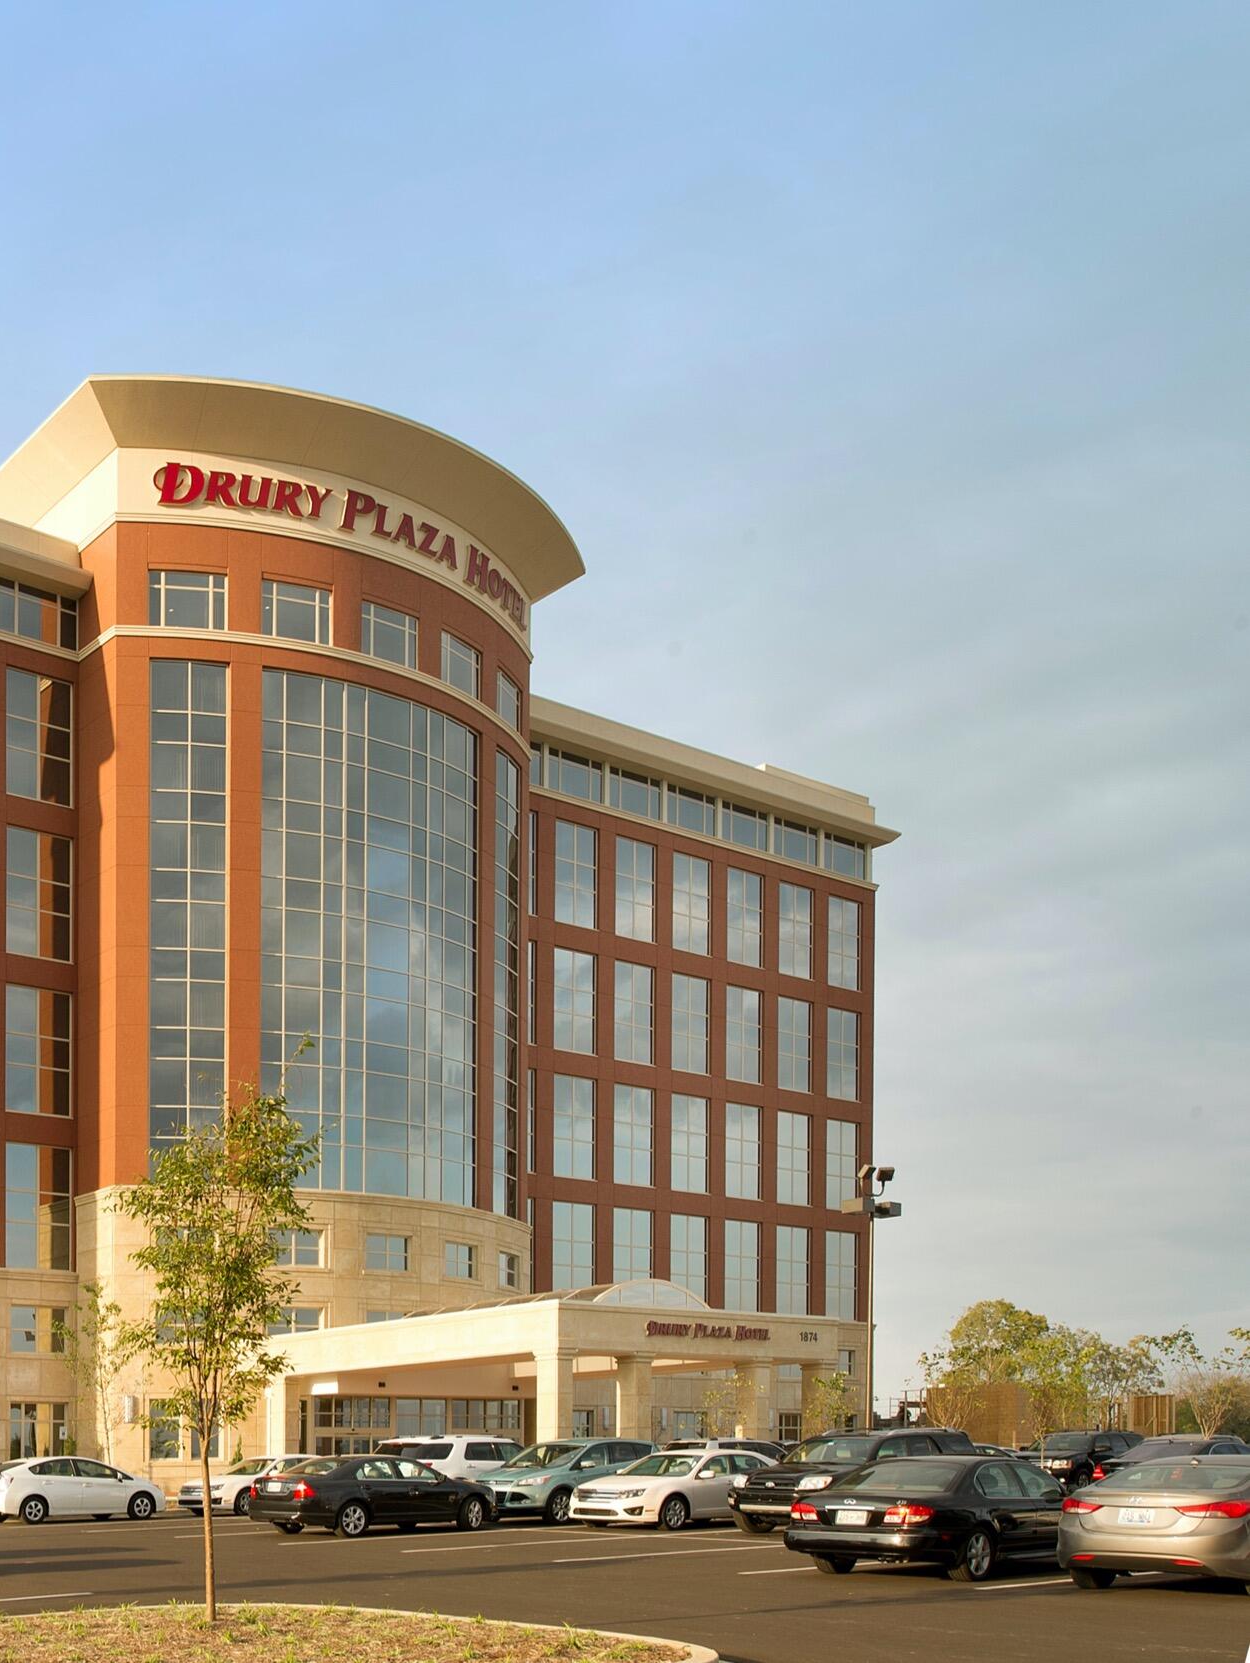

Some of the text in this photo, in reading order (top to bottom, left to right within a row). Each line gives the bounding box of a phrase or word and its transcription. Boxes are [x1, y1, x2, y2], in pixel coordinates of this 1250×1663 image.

[153, 462, 333, 518] DRURY
[338, 488, 458, 571] PLAZA
[692, 1323, 732, 1339] PLAZA
[799, 1332, 818, 1342] 1874
